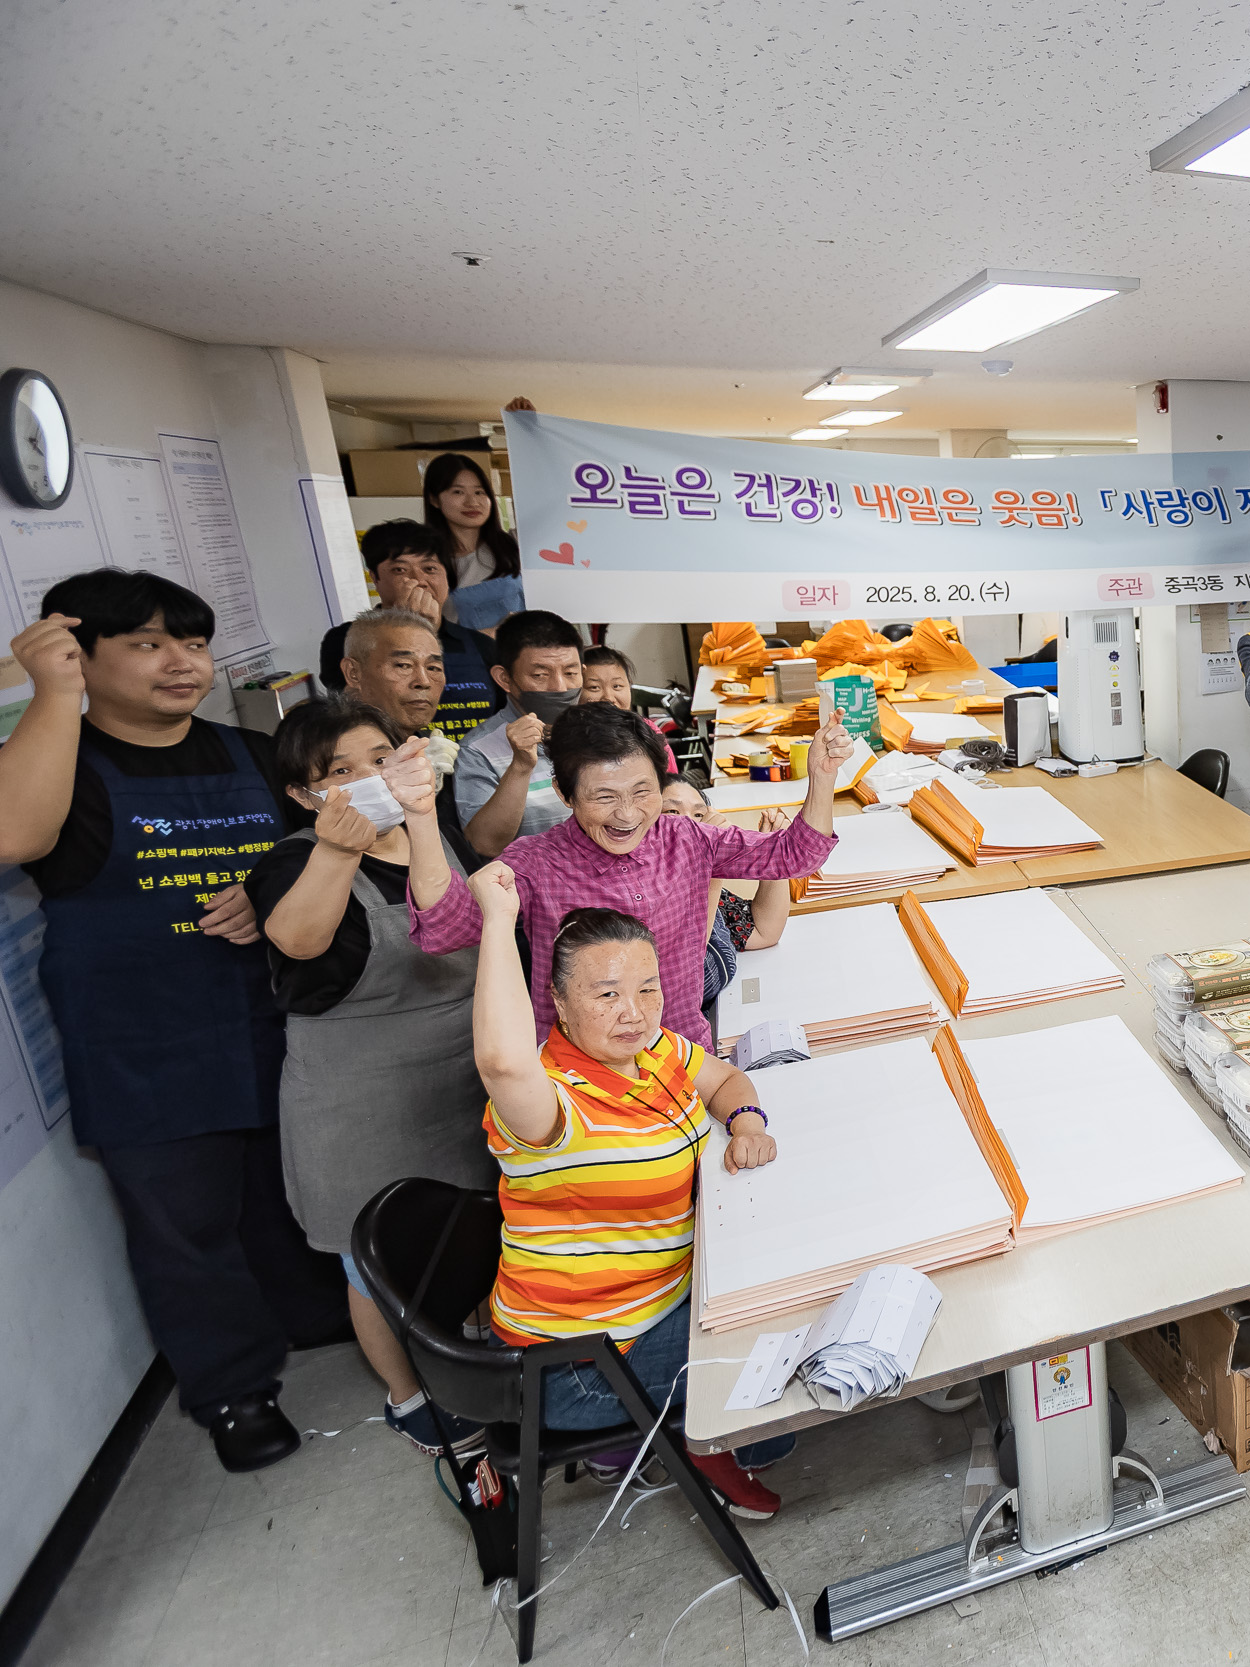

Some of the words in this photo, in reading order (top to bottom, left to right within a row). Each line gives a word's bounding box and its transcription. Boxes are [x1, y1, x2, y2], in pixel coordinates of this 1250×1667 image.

[568, 461, 719, 520] 오늘은
[731, 470, 843, 523] 건강!
[850, 482, 982, 526] 내일은
[990, 487, 1081, 528] 웃음!
[1099, 484, 1232, 528] 「사랑이
[795, 583, 839, 607] 일자
[865, 584, 918, 604] 2025.
[923, 583, 941, 604] 8.
[1106, 576, 1144, 597] 주관
[1163, 572, 1225, 594] 중곡3동
[139, 876, 154, 889] 넌
[159, 872, 203, 887] 쇼핑백
[205, 871, 232, 885] 들고
